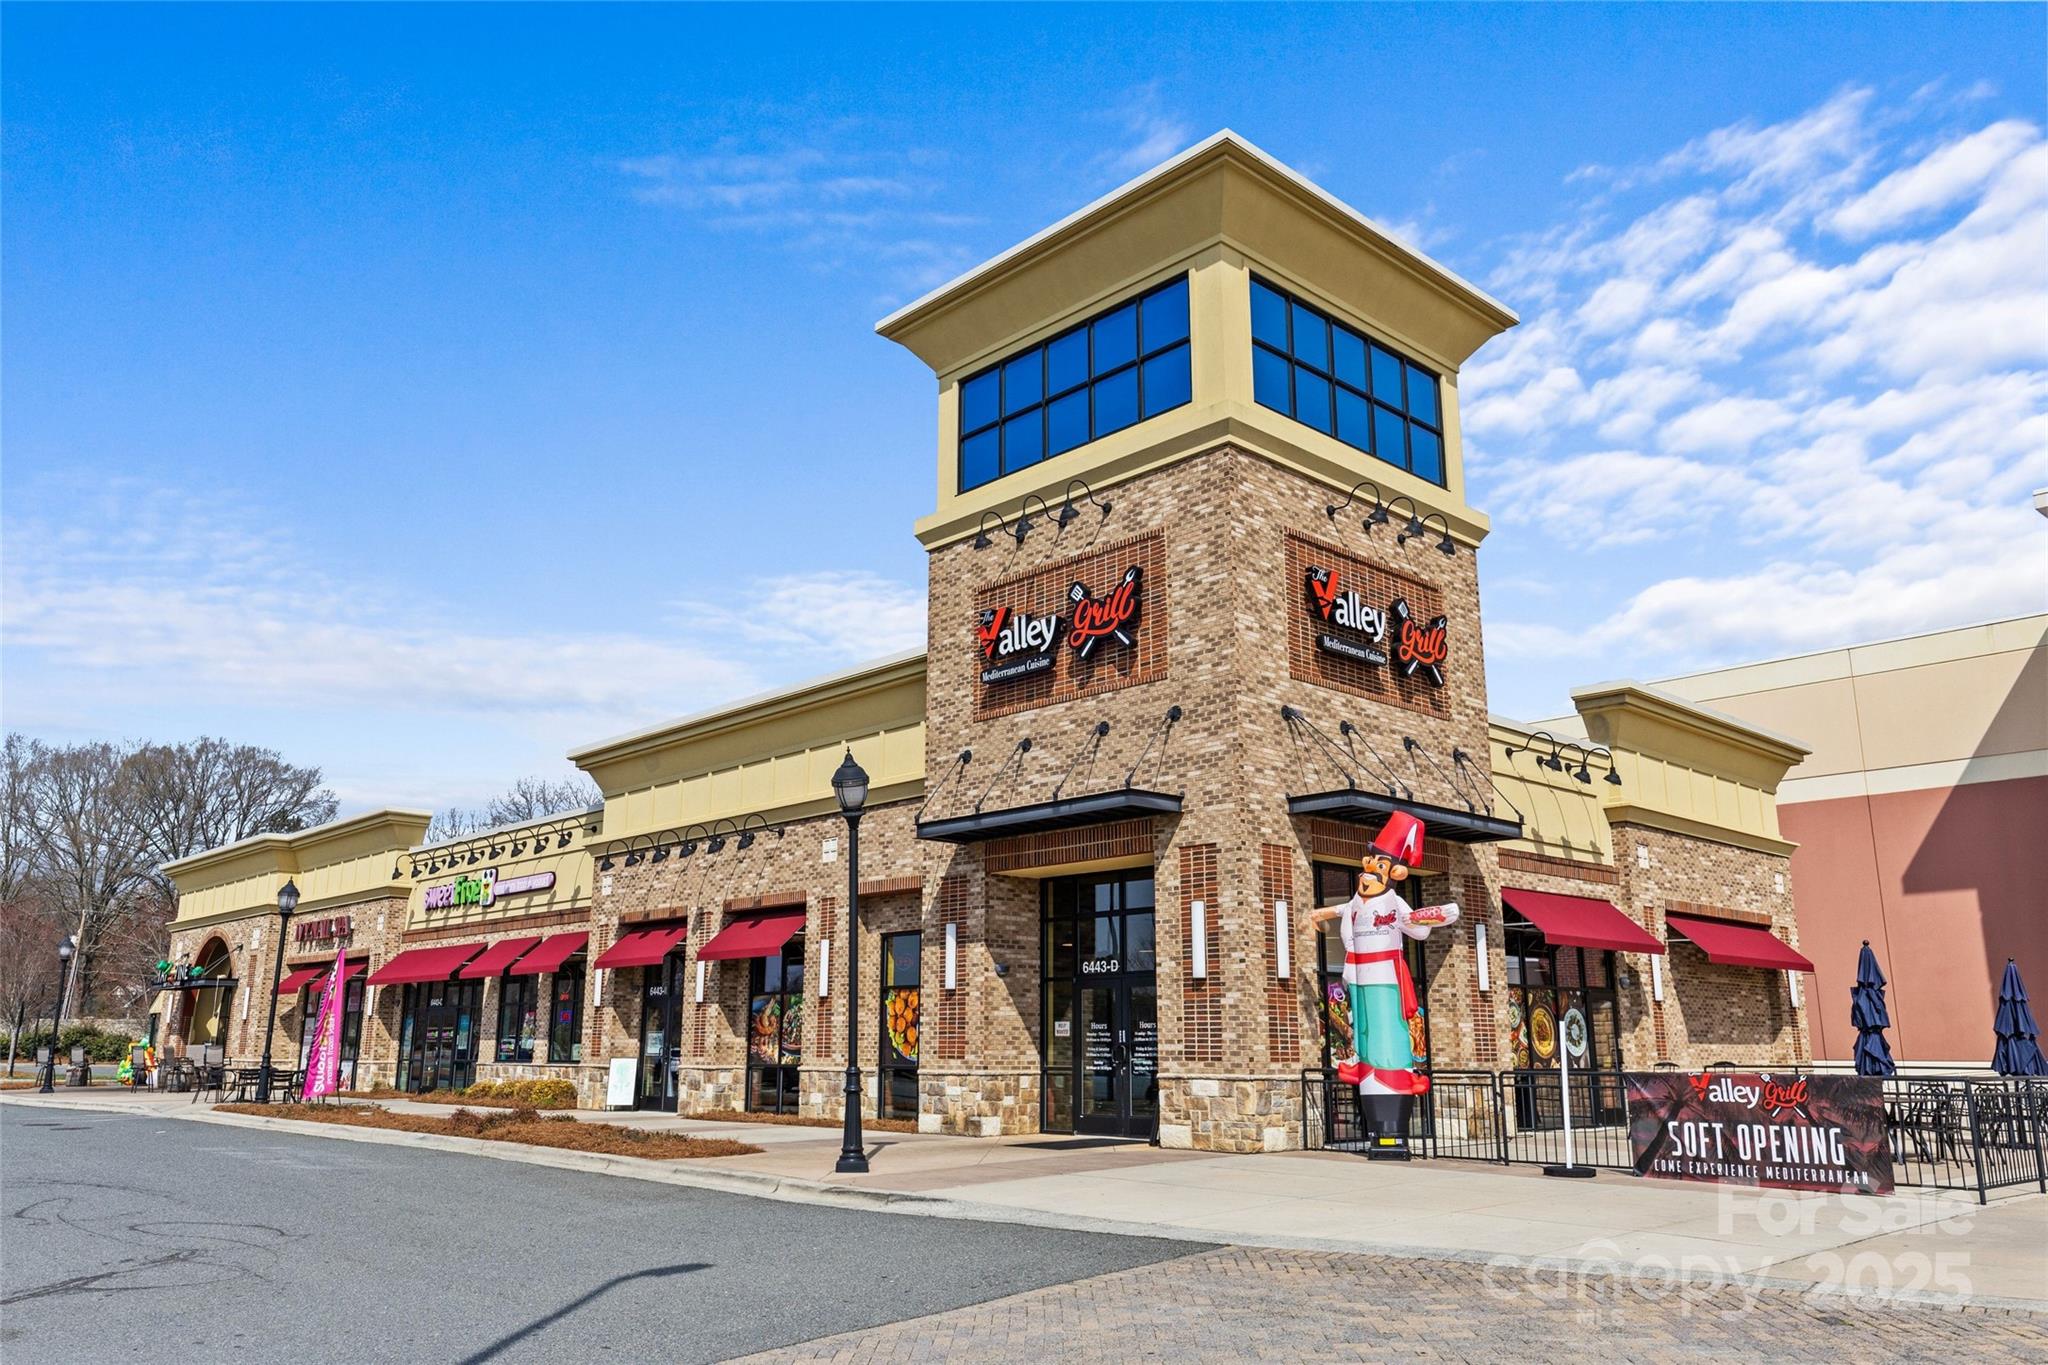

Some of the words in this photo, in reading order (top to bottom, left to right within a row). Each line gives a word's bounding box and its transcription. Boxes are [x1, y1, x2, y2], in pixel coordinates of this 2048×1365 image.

[1312, 567, 1328, 582] The
[1312, 570, 1387, 643] Valley
[976, 607, 1057, 658] Valley
[1323, 635, 1366, 658] Mediterranean
[1365, 649, 1387, 664] Cuisine
[982, 665, 1026, 681] Mediterranean
[1026, 657, 1050, 672] Cuisine
[1082, 960, 1120, 973] 6443-D
[1091, 1022, 1107, 1030] Hours
[1139, 1021, 1156, 1029] Hours
[1688, 1073, 1760, 1109] Valley
[1668, 1121, 1724, 1159] SOFT
[1737, 1124, 1846, 1166] OPENING
[1654, 1159, 1682, 1173] COME
[1689, 1161, 1758, 1179] EXPERIENCE
[1766, 1166, 1869, 1185] MEDITERRANEAN
